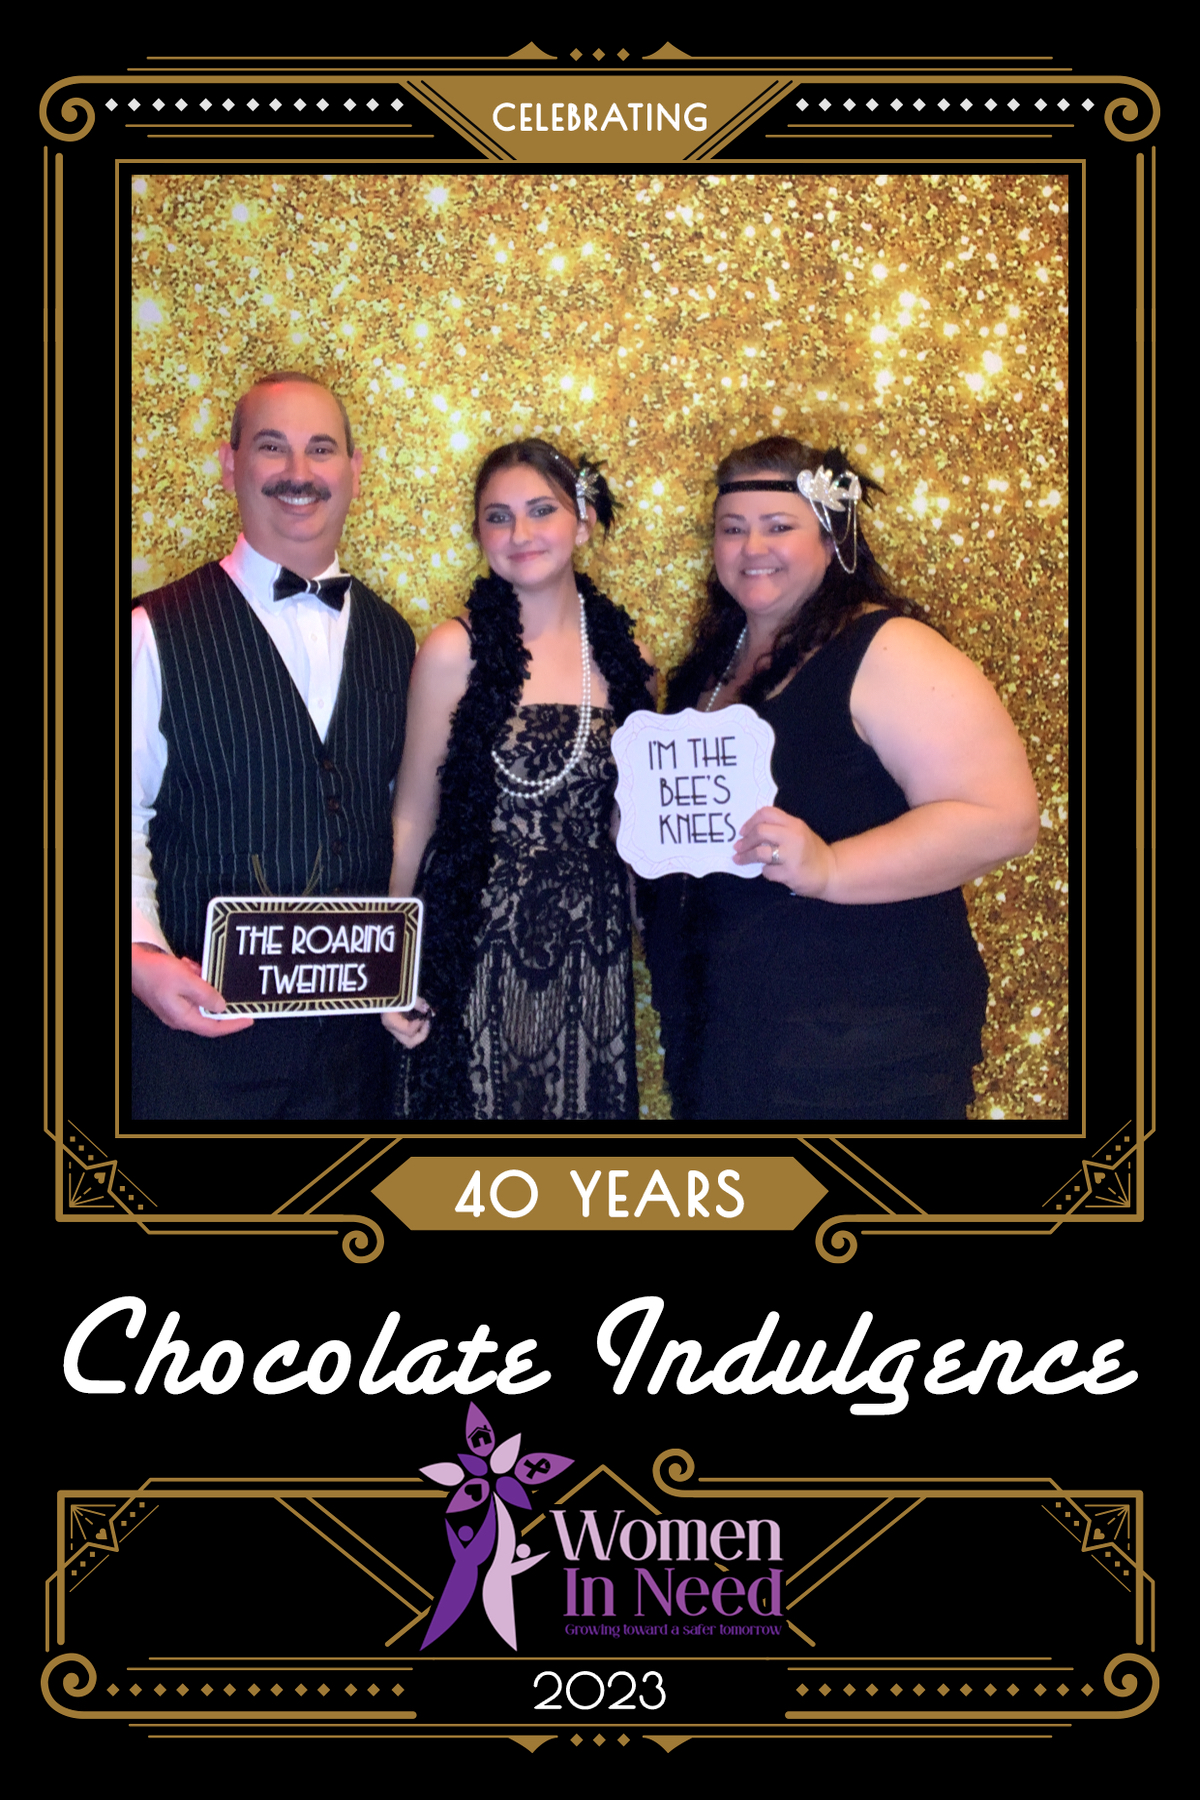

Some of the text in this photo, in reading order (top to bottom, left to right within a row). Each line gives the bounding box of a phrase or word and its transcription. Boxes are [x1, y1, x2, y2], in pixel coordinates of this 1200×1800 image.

[649, 737, 736, 769] I'M THE
[660, 775, 730, 806] BEE'S
[660, 813, 735, 843] KNEES
[236, 925, 394, 955] THE ROARING
[259, 964, 367, 994] TWENTIES
